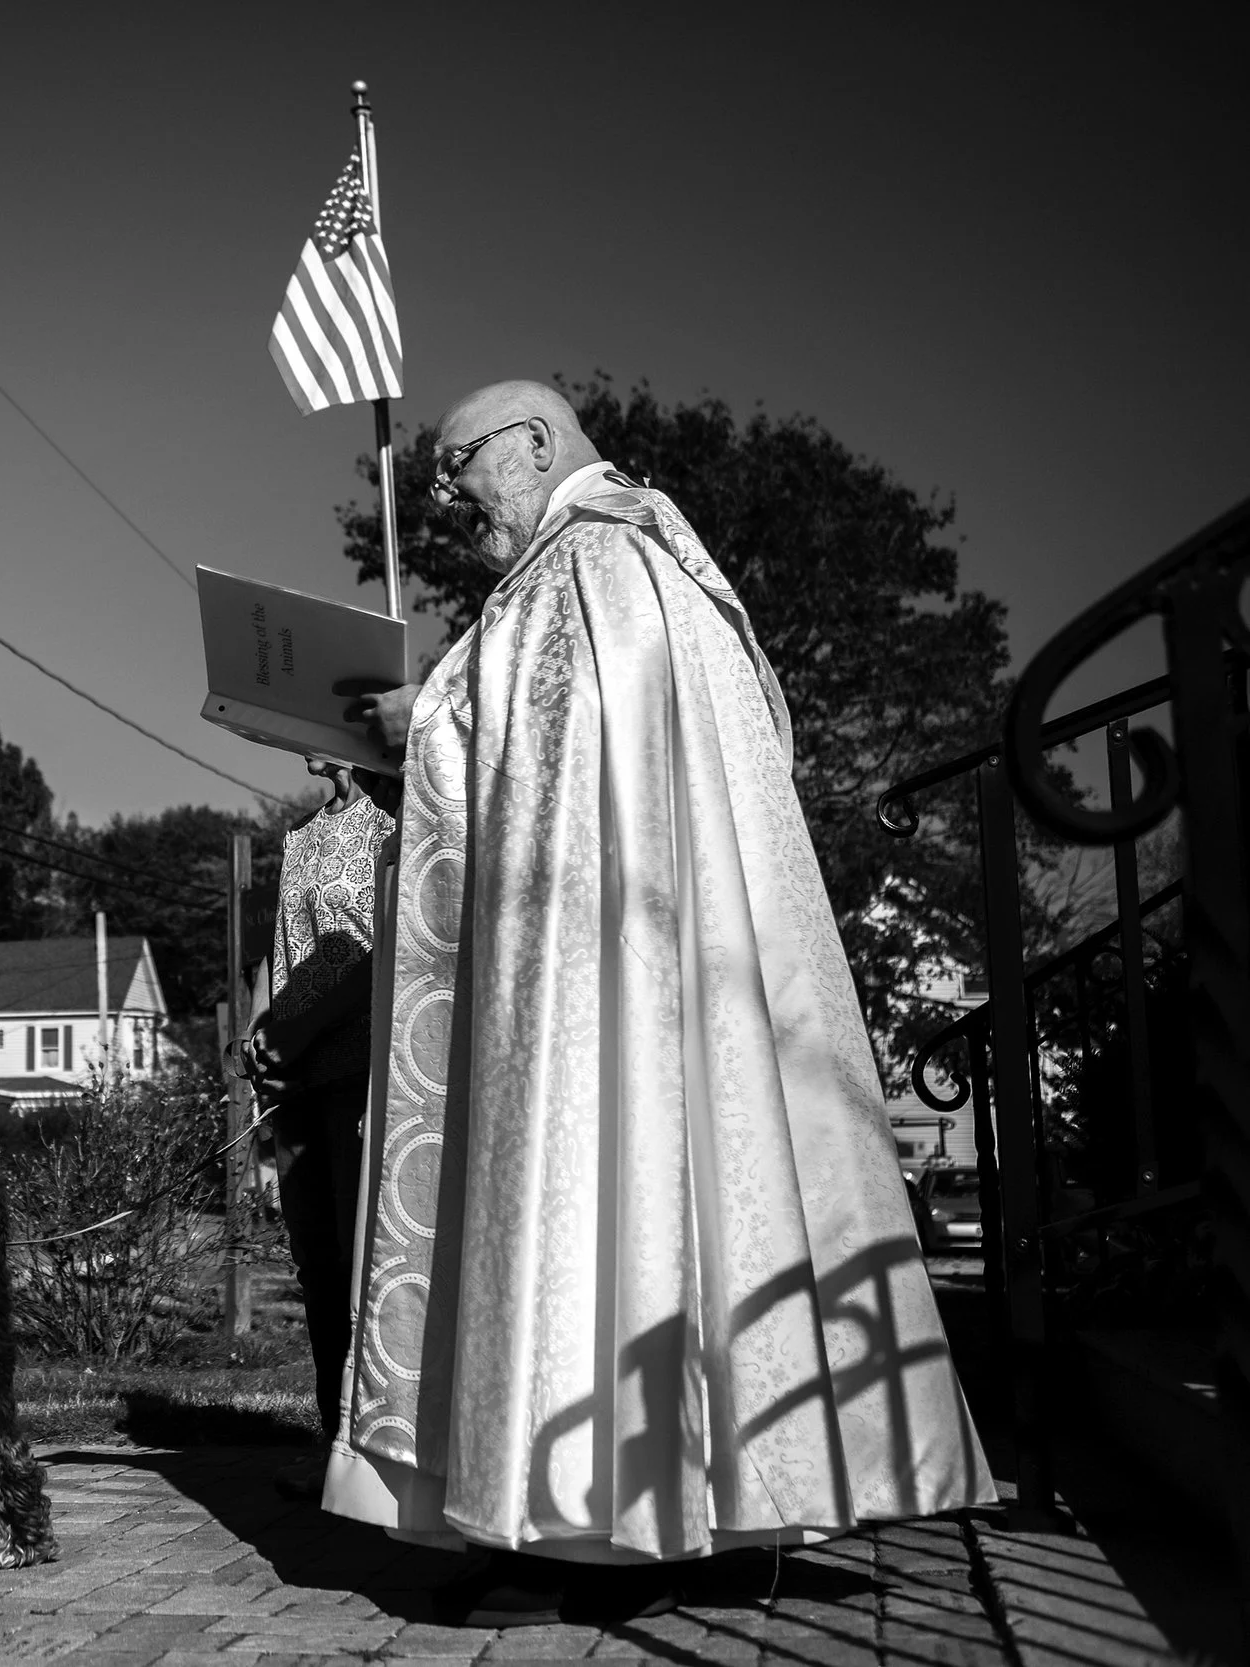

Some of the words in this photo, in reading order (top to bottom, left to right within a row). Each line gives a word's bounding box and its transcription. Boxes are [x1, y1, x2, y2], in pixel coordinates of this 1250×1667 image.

[251, 603, 266, 622] the
[251, 622, 267, 637] of
[254, 639, 272, 686] Blessing
[277, 627, 295, 677] Animals
